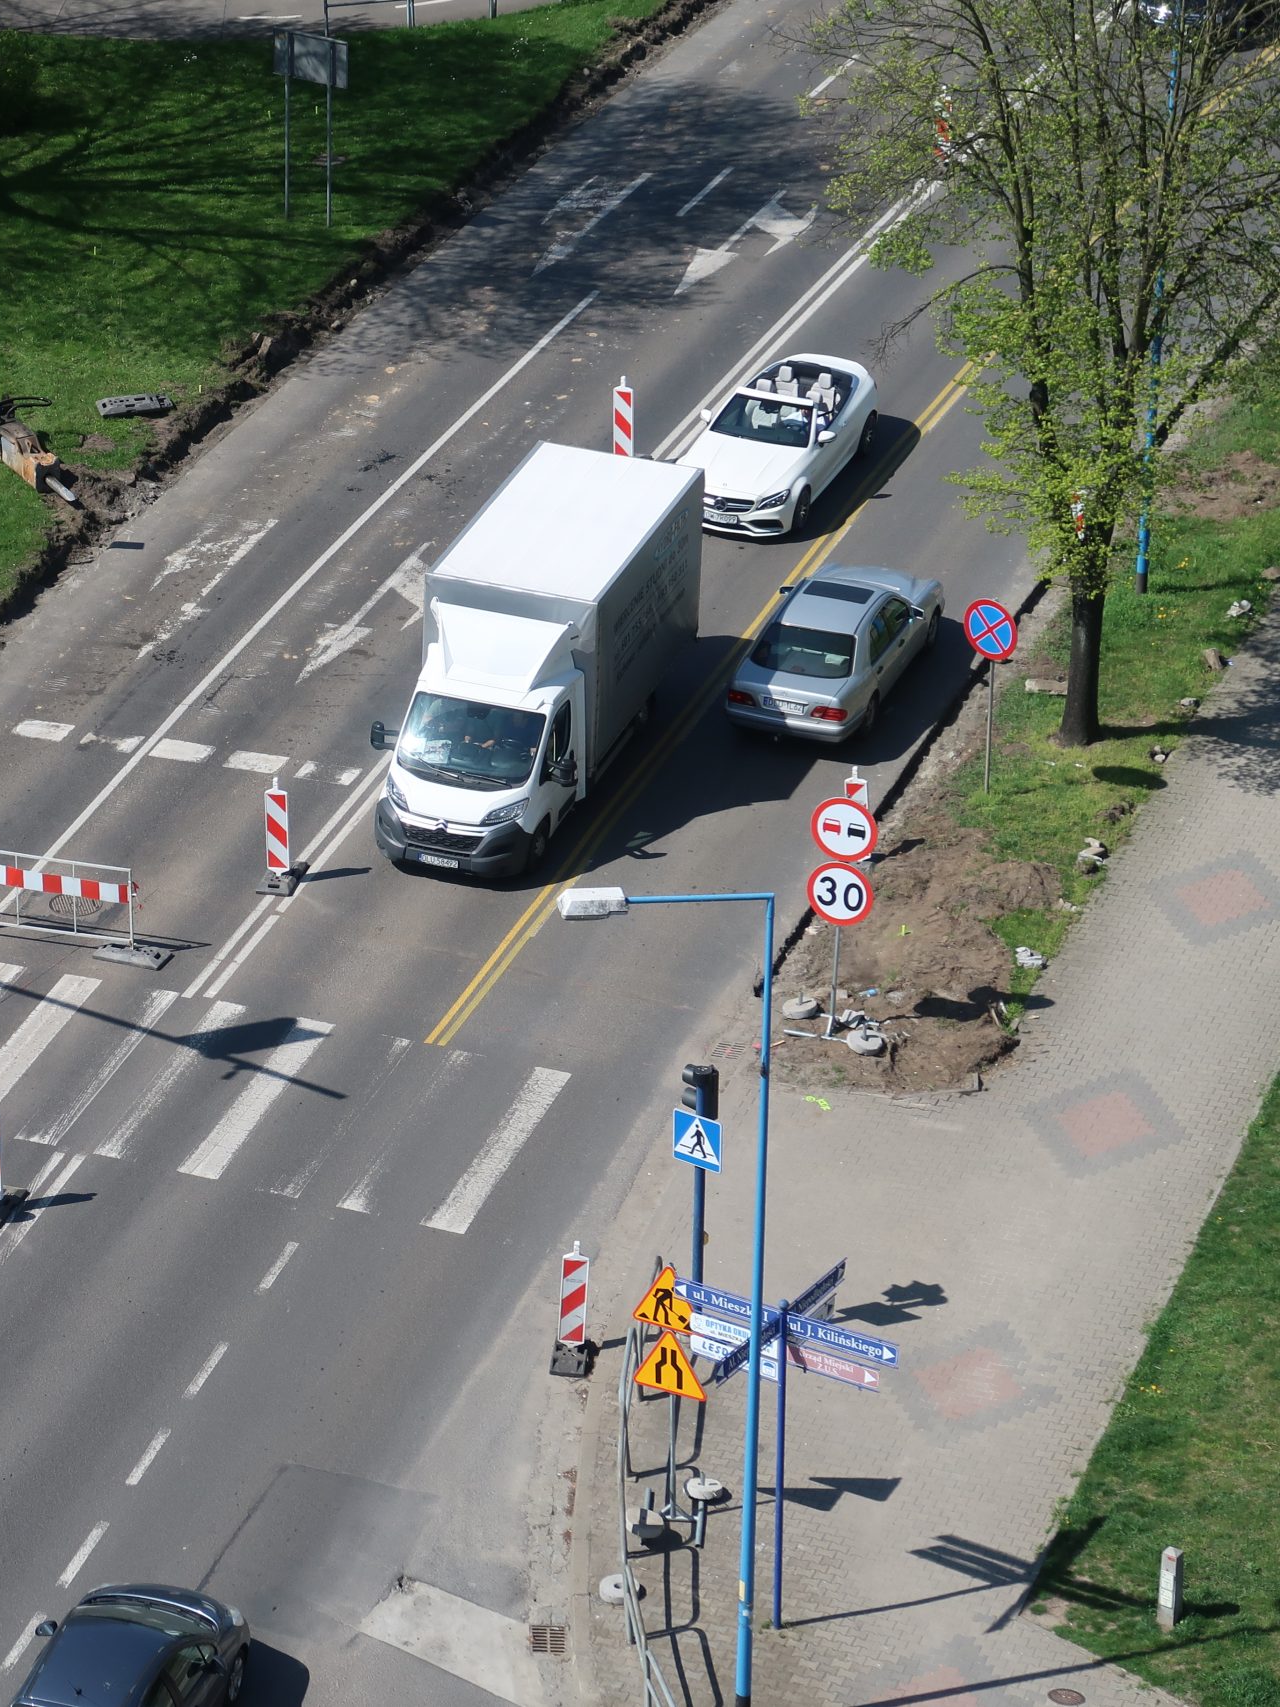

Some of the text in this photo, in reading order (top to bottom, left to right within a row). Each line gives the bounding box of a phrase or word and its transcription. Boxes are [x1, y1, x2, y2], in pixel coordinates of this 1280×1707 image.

[816, 875, 864, 912] 30
[692, 1290, 708, 1303] ul.
[711, 1297, 753, 1319] Mieszk
[705, 1319, 733, 1335] OPTYKA
[789, 1320, 882, 1358] ul. J. Kilińskiego
[823, 1356, 854, 1374] Miejski
